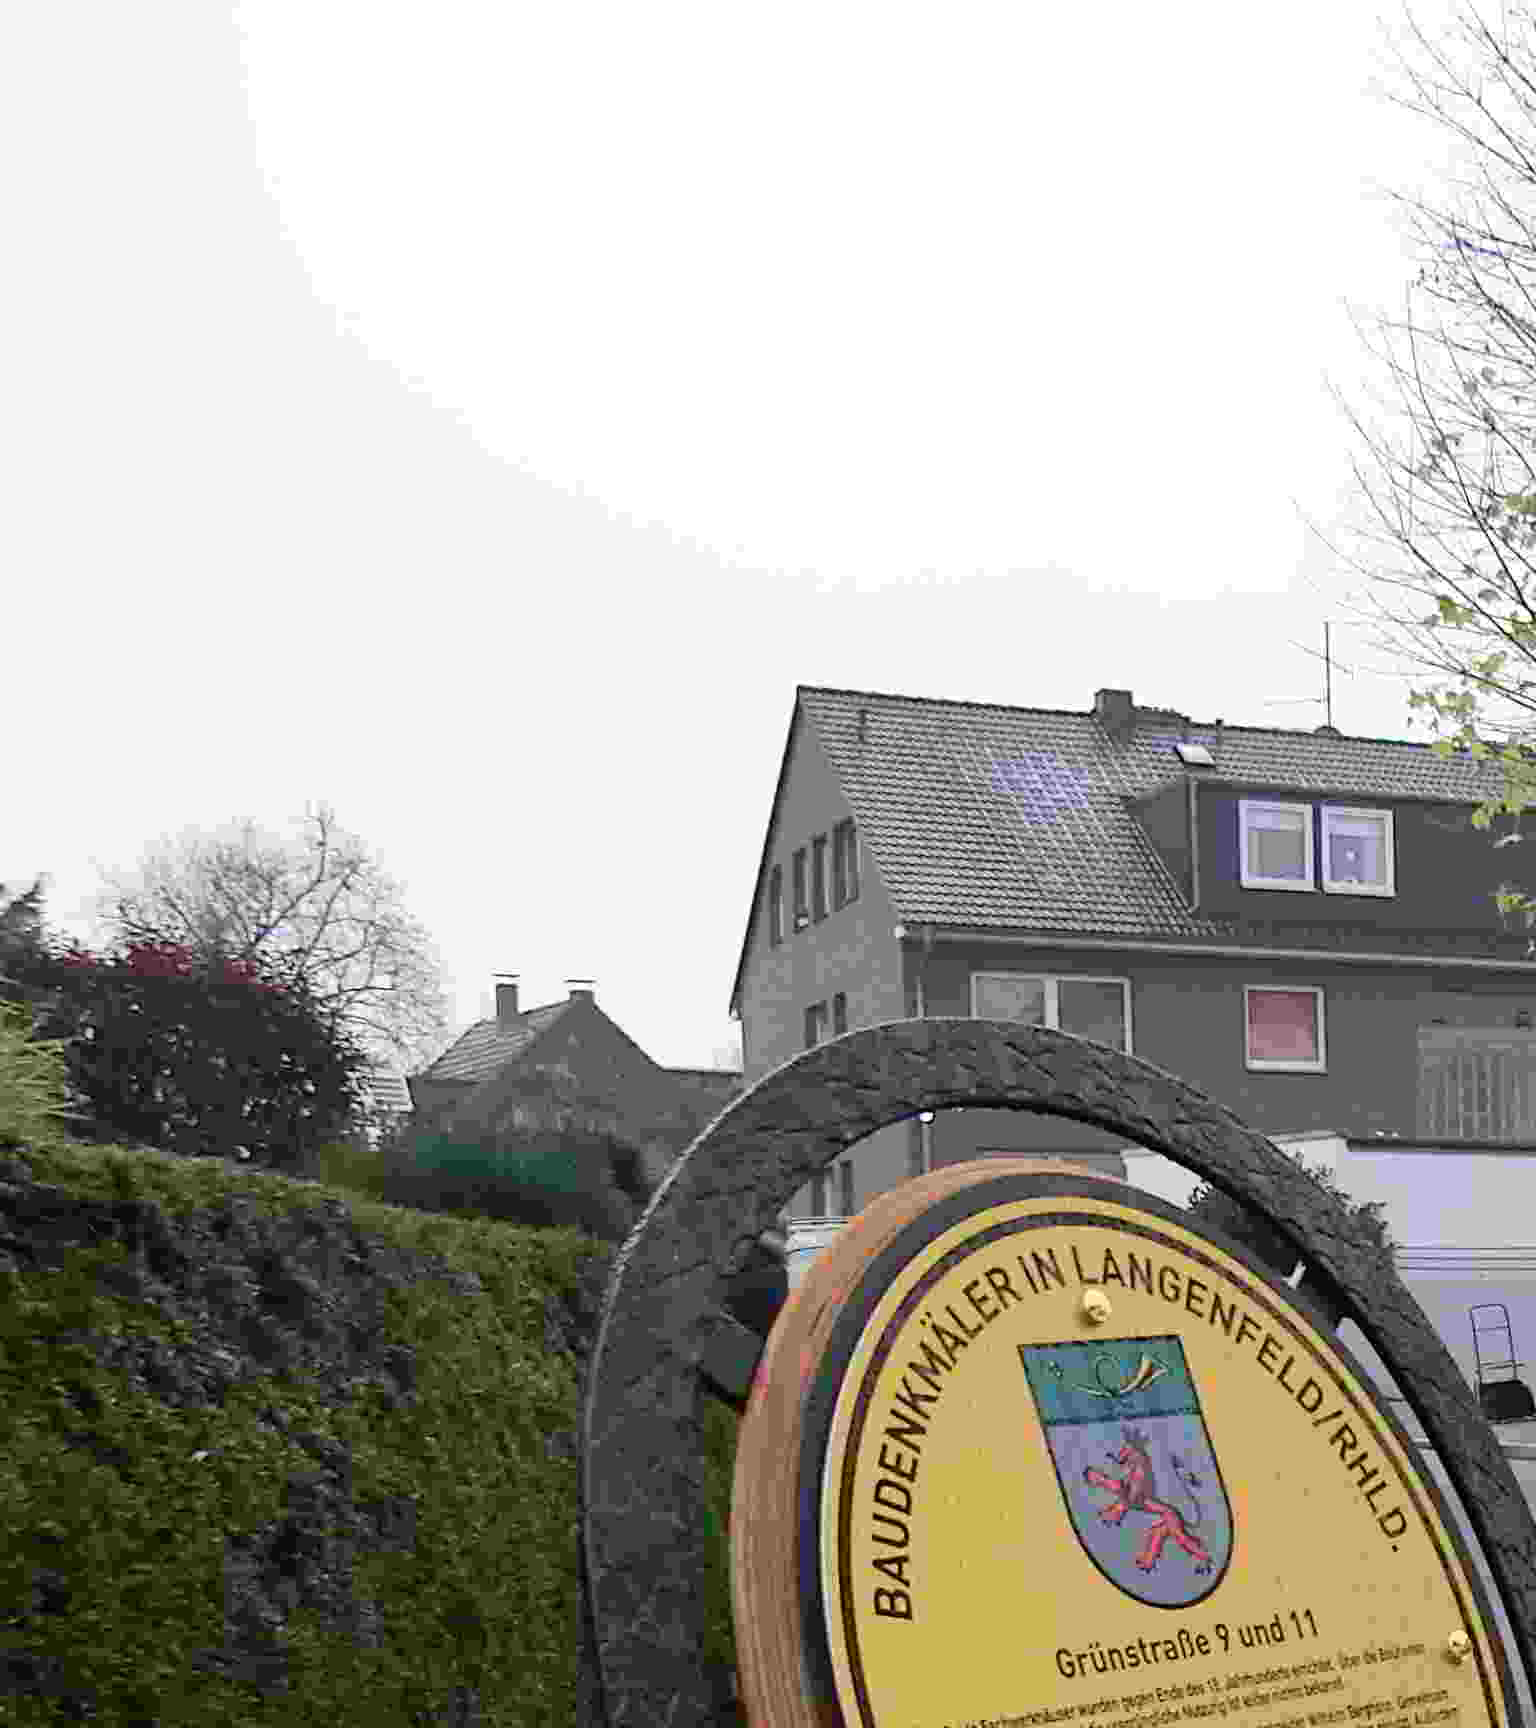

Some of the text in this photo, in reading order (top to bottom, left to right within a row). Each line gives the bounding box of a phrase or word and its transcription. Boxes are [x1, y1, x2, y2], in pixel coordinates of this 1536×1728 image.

[872, 1267, 1024, 1622] BAUDENKMÄLER
[1023, 1246, 1064, 1295] IN
[1055, 1608, 1319, 1678] Grünstraße 9 und 11
